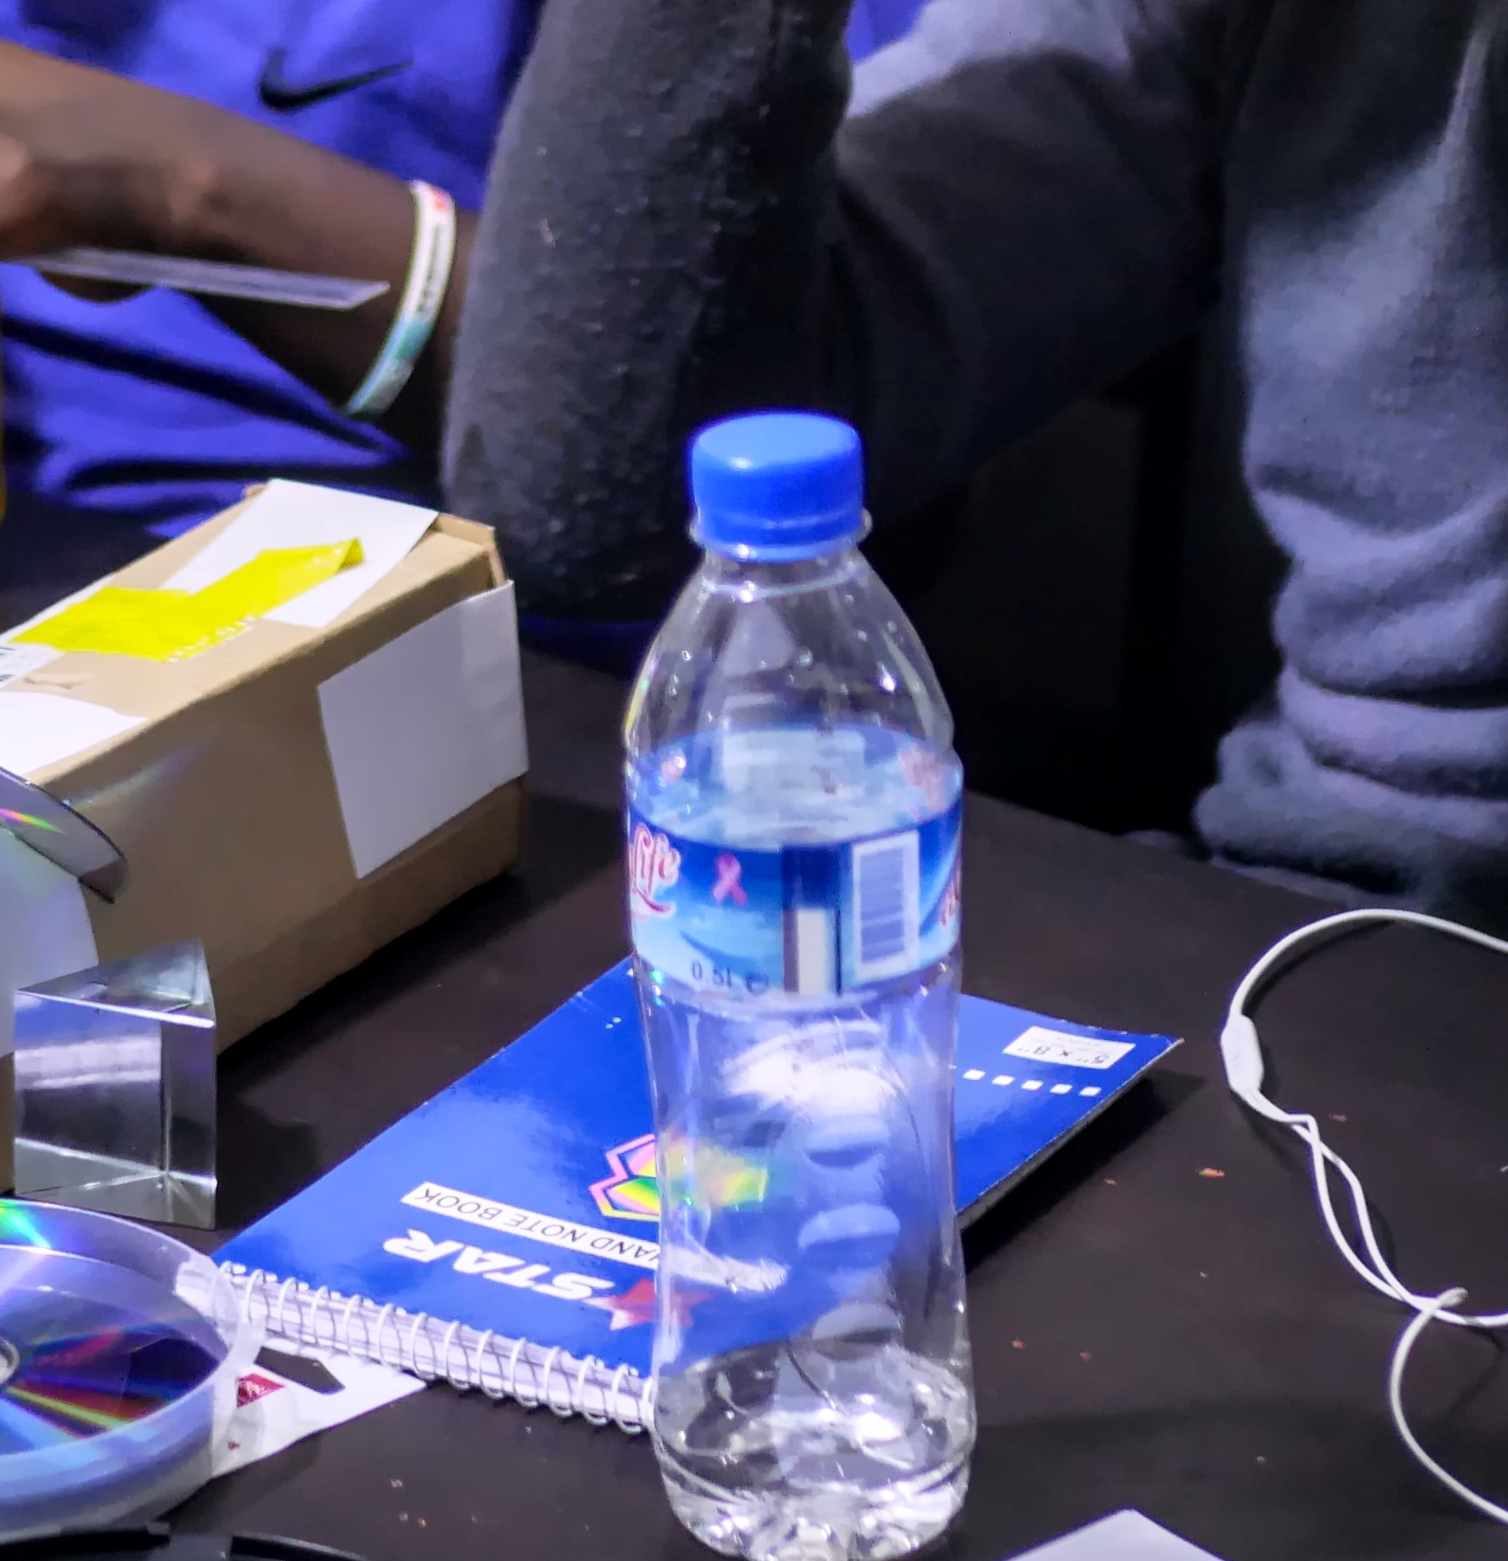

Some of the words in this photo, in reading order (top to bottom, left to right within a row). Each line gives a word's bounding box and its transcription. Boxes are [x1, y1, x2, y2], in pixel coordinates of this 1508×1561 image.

[417, 1188, 504, 1222] BOOK
[506, 1214, 588, 1244] NOTE
[383, 1229, 616, 1301] STAR
